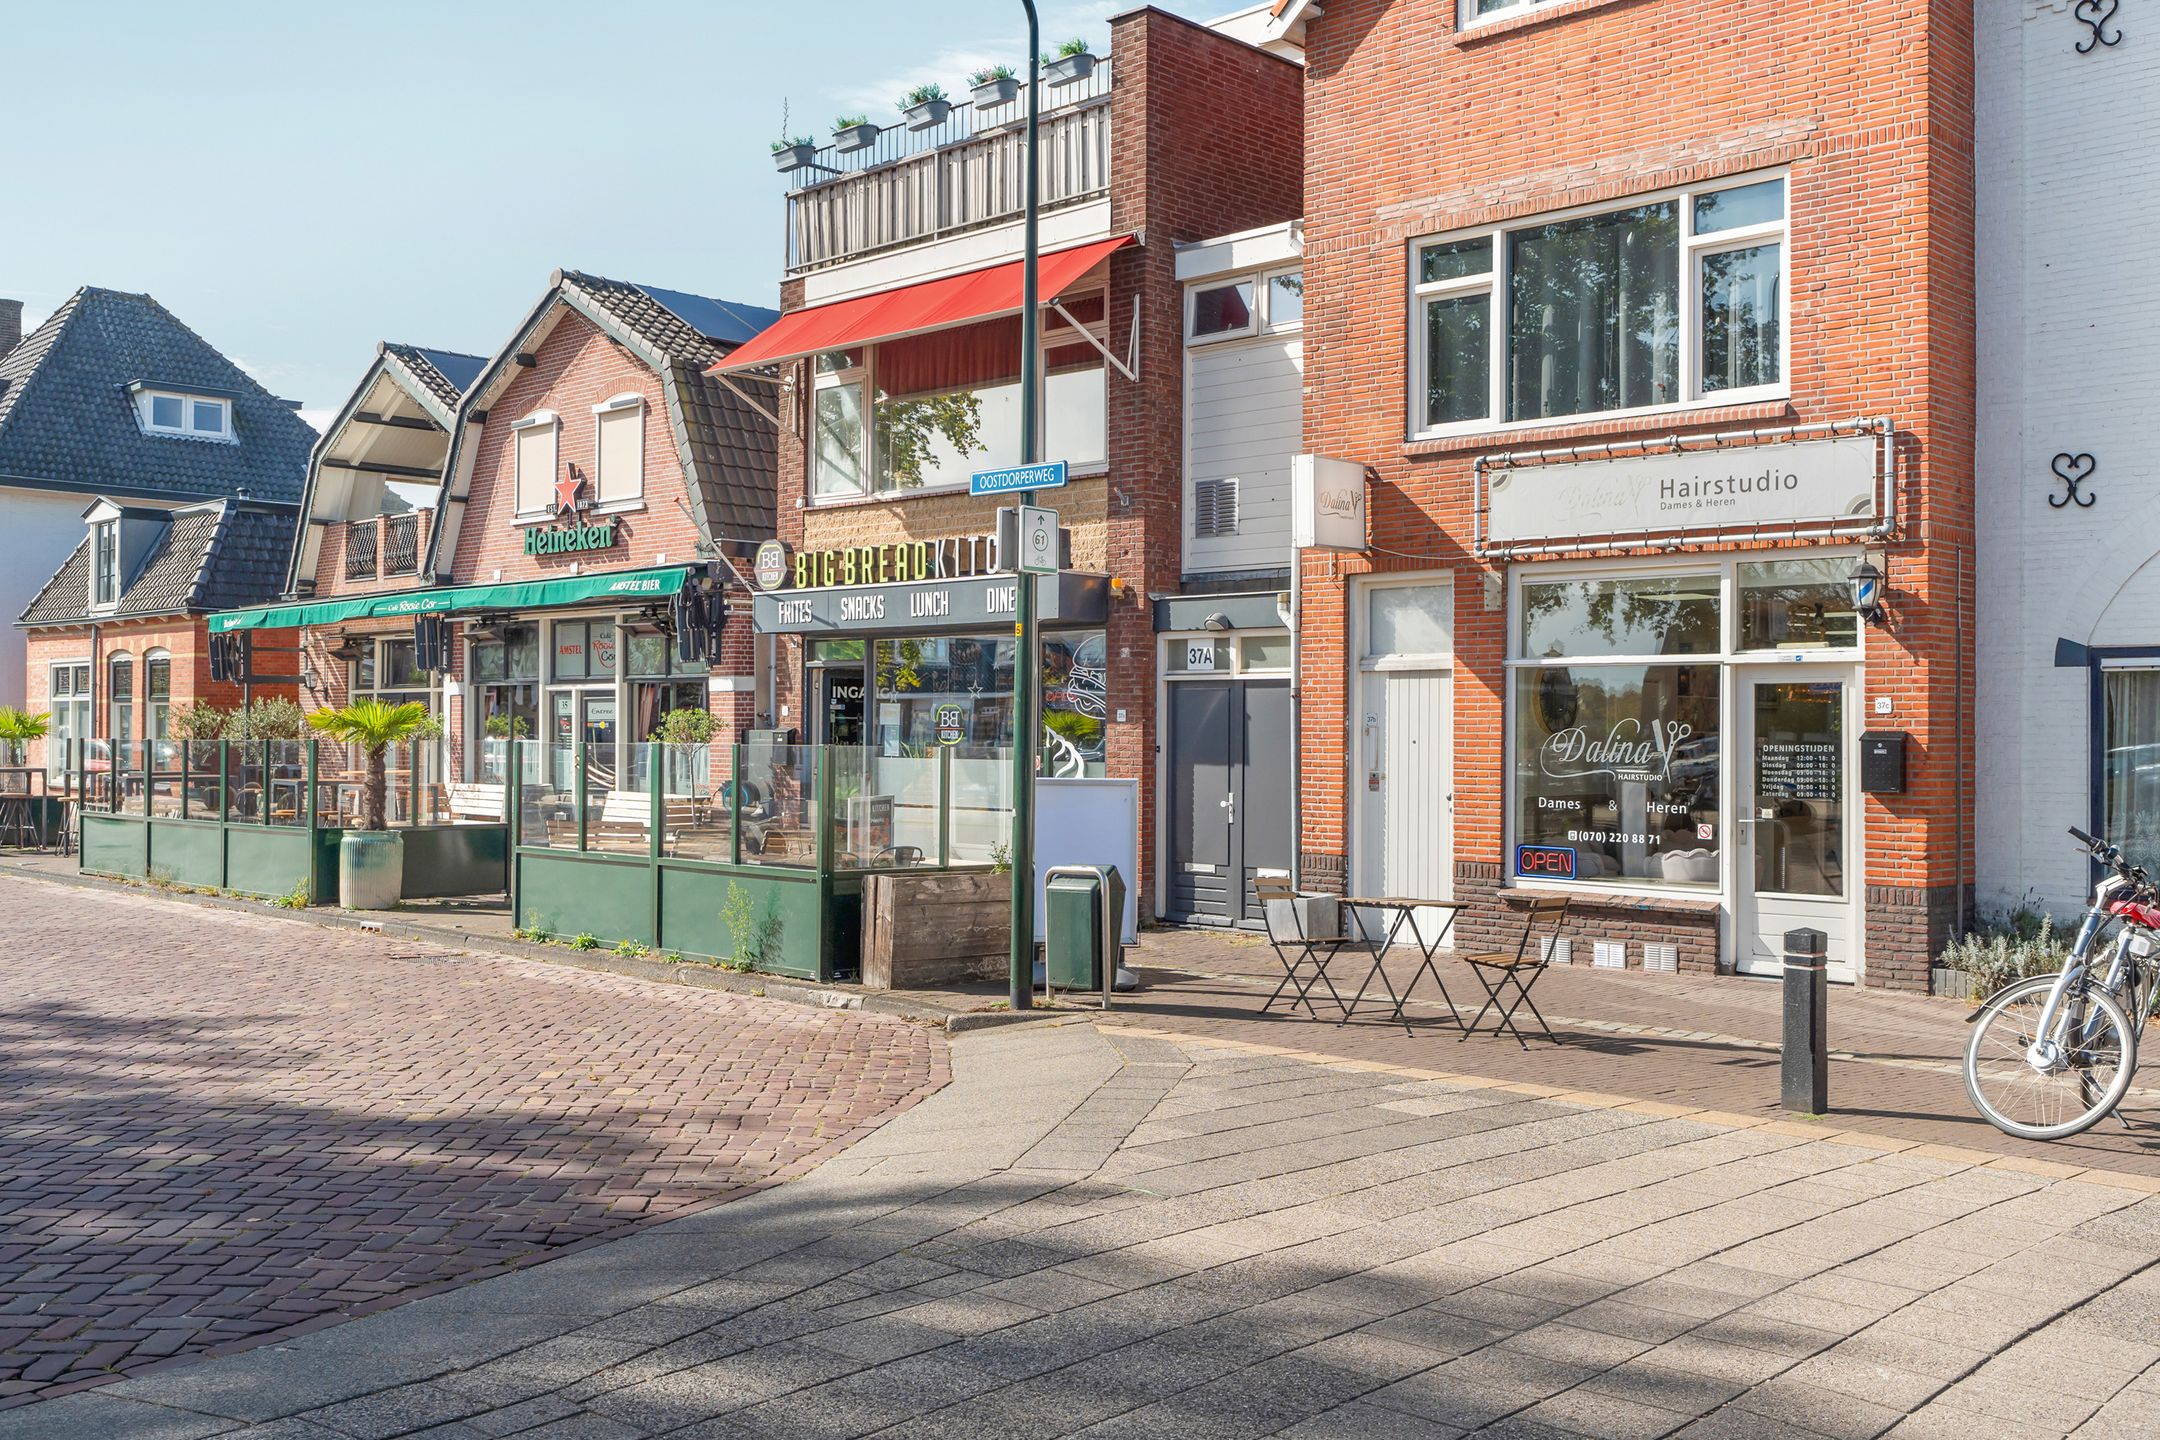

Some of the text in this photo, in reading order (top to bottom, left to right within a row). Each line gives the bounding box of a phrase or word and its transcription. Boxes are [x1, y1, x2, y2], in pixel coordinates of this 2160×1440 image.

[980, 468, 1054, 489] OOSTDORPERWEG
[1660, 469, 1798, 499] Hairstudio
[1318, 489, 1351, 511] Dalina
[1660, 498, 1736, 510] Dames & Heren
[524, 521, 613, 555] Heineken
[1034, 535, 1046, 545] 61
[641, 579, 661, 591] BIER
[400, 600, 420, 611] Rooie
[421, 598, 437, 609] Cor
[778, 586, 1017, 624] FRITES SNACKS LUNCH DINE
[560, 644, 582, 655] AMSTEL
[1189, 648, 1212, 664] 37A
[1541, 718, 1654, 768] Dalina
[1617, 773, 1663, 782] HAIRSTUDIO
[1538, 797, 1687, 814] Dames & Heren
[1578, 831, 1661, 844] (070) 220 88 71
[1521, 851, 1572, 873] OPEN
